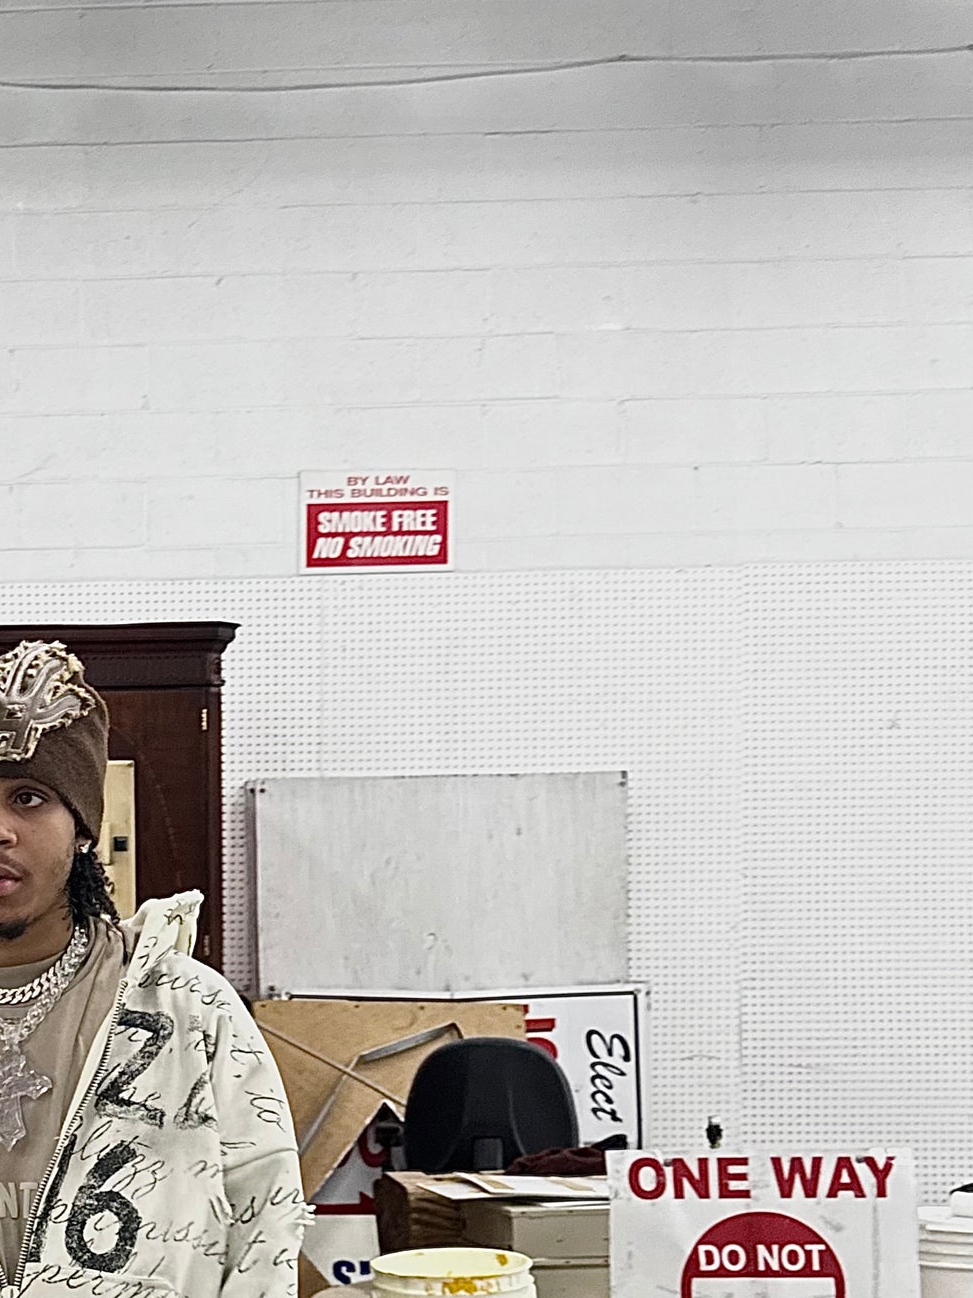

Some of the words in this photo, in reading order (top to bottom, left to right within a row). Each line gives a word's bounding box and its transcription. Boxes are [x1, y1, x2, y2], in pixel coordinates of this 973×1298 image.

[307, 489, 344, 498] THIS
[351, 487, 428, 498] BUILDING
[434, 486, 450, 496] IS
[347, 476, 369, 486] BY
[375, 475, 410, 486] LAW
[317, 511, 387, 533] SMOKE
[391, 509, 437, 531] FREE
[312, 537, 345, 558] NO
[346, 535, 442, 558] SMOKING
[585, 1028, 631, 1123] Elect
[628, 1157, 752, 1200] ONE
[770, 1156, 896, 1199] WAY
[698, 1244, 747, 1271] DO
[757, 1244, 826, 1271] NOT
